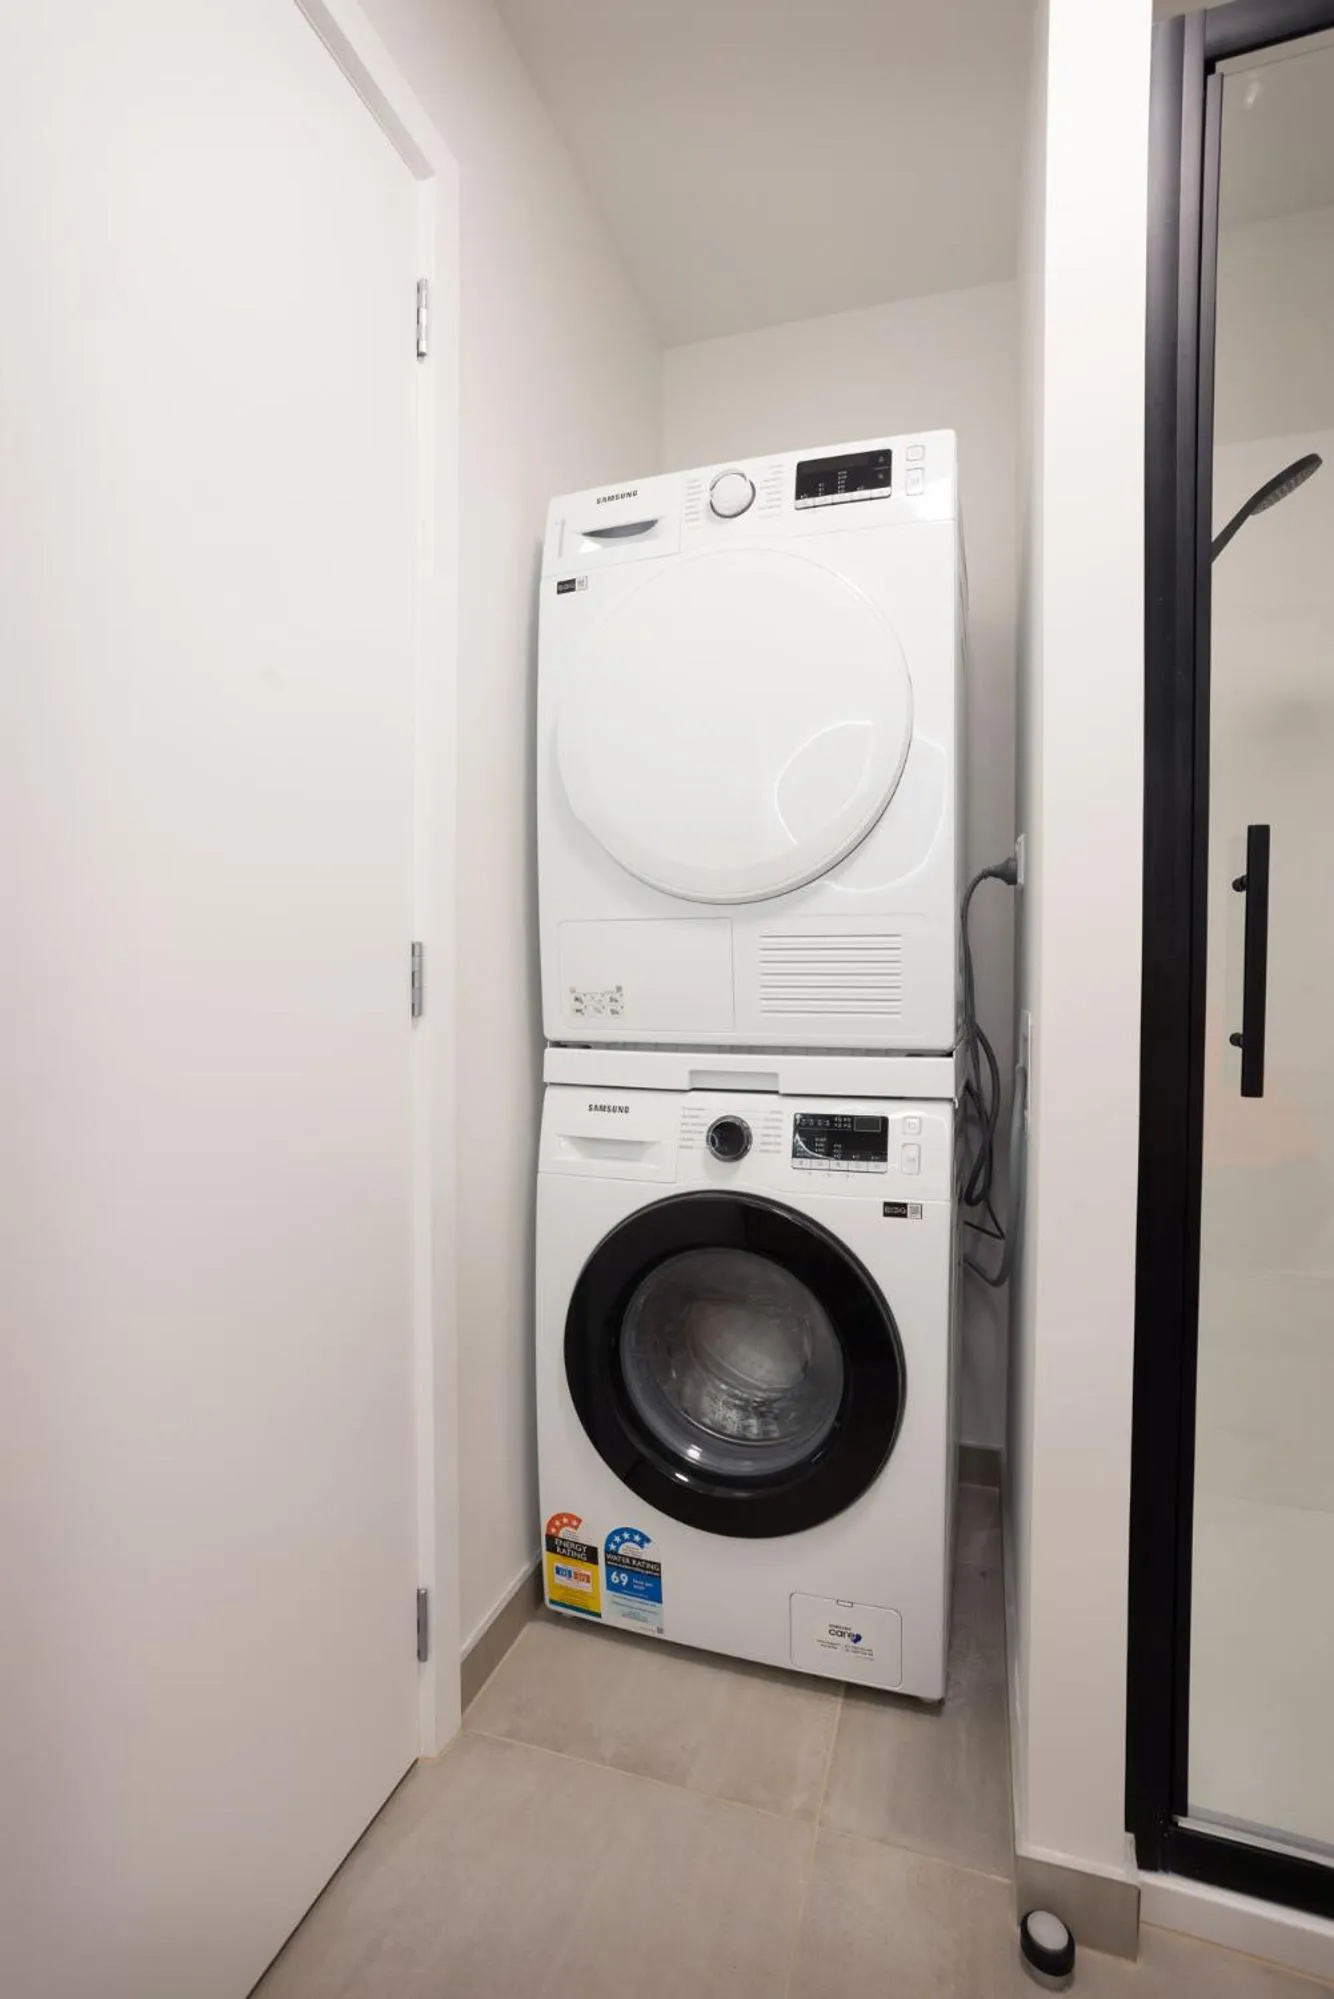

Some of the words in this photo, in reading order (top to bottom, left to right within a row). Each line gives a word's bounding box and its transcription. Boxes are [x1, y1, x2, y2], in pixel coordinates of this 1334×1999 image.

[596, 490, 638, 504] SAMSUNG
[588, 1104, 630, 1114] SAMSUNG
[555, 1538, 588, 1553] ENERGY
[556, 1546, 588, 1561] RATING
[606, 1553, 632, 1564] WATER
[632, 1558, 660, 1571] RATING
[611, 1571, 629, 1586] 69
